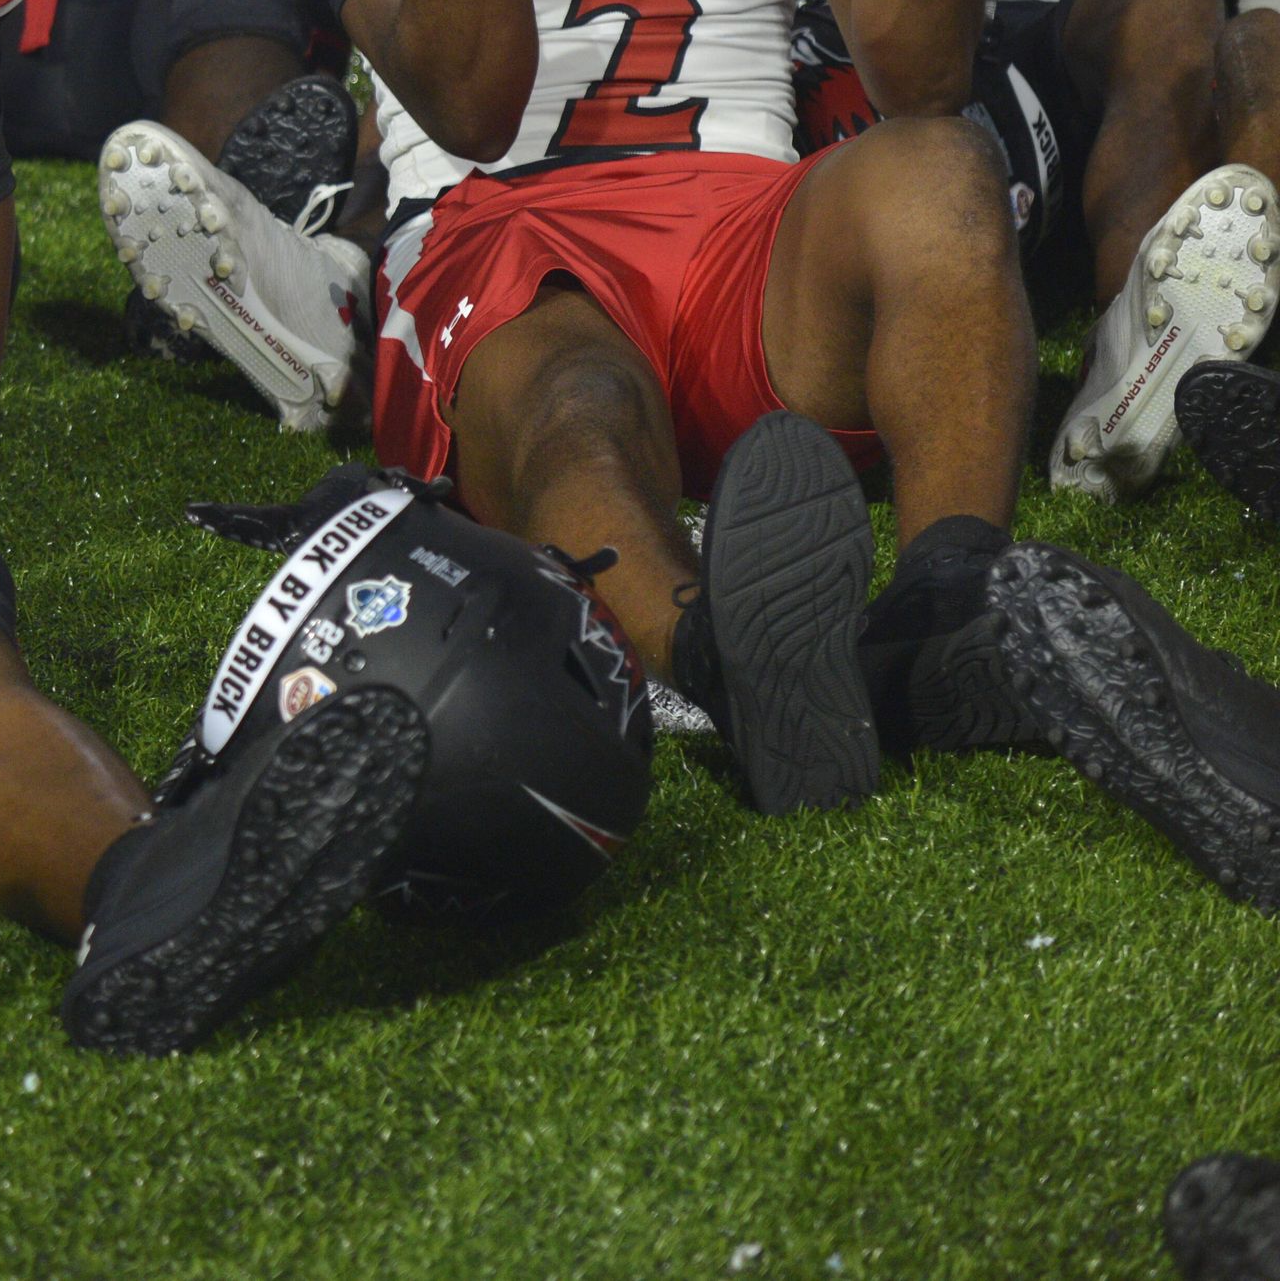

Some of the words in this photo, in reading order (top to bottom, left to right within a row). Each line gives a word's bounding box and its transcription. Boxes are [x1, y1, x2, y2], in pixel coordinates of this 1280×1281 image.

[207, 277, 264, 332] ARMOUR
[264, 334, 309, 380] UNDER
[1145, 326, 1181, 373] UNDER
[1102, 374, 1146, 435] ARMOUR
[302, 501, 389, 576] BRICK
[268, 573, 312, 624] BY
[212, 623, 277, 723] BRICK
